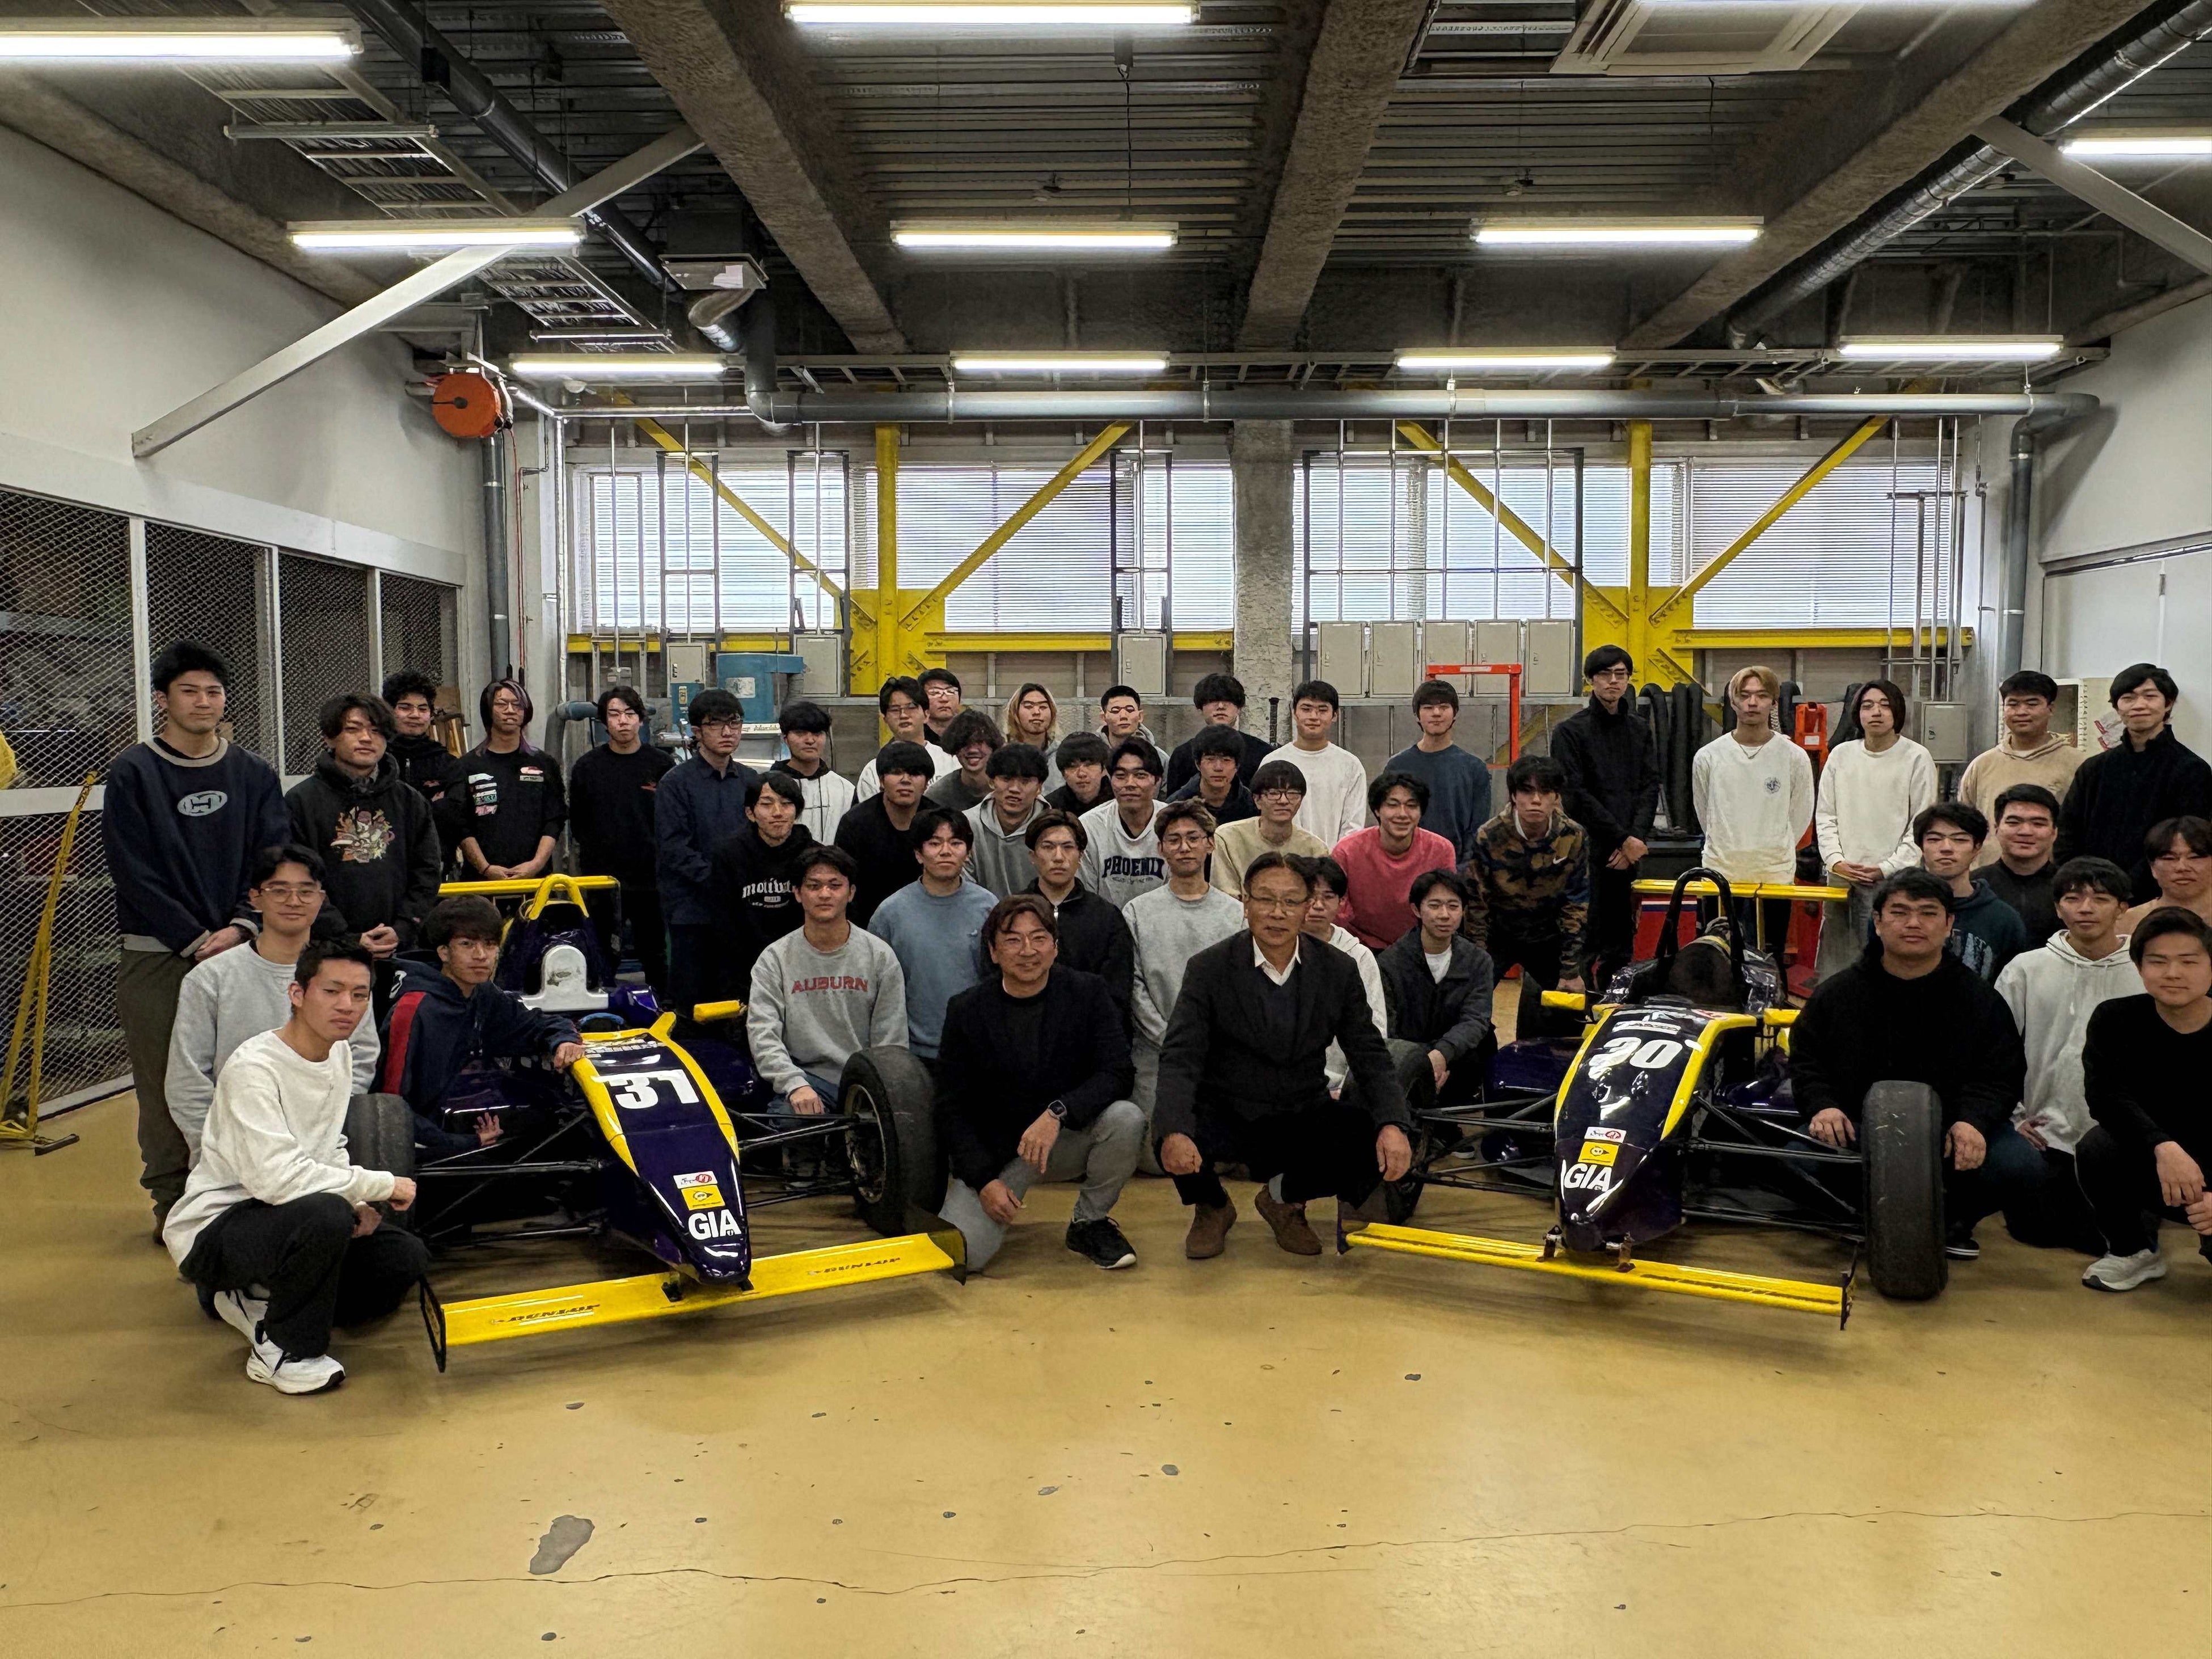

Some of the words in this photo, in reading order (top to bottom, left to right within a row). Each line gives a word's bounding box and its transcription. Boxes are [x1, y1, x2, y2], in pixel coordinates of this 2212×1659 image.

[791, 976, 868, 994] AUBURN
[1588, 1037, 1683, 1069] 20
[605, 1070, 700, 1109] 31
[1564, 1163, 1612, 1192] GIA
[688, 1209, 742, 1240] GIA
